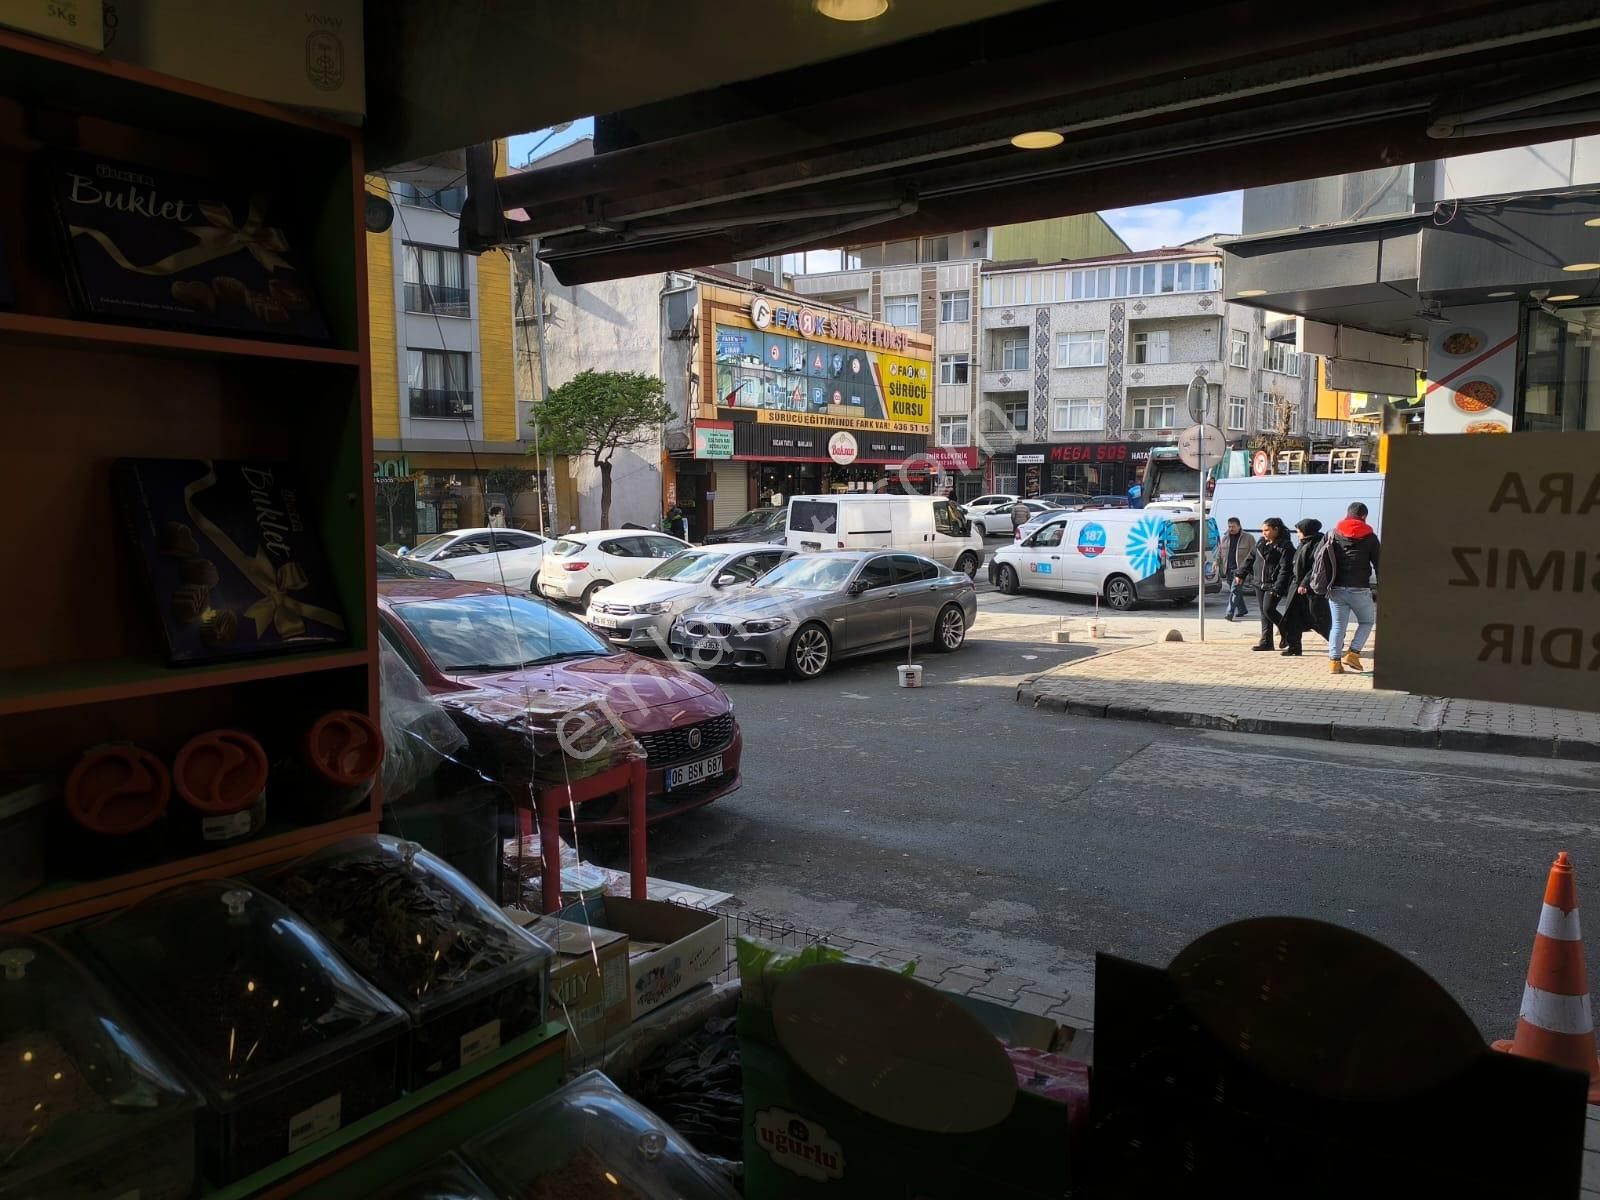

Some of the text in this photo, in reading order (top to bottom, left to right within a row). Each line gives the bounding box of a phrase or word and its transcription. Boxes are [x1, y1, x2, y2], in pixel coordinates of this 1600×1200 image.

[66, 171, 193, 223] Buklet
[775, 306, 826, 338] FARK
[829, 316, 874, 346] SÜRÜCÜ
[873, 326, 909, 353] KURSU
[889, 380, 927, 400] SÜRÜCÜ
[892, 400, 924, 417] KURSU
[768, 411, 930, 433] SÜRÜCÜ EĞİTİMİNDE FARK VAR! 436 51 15
[1050, 446, 1091, 461] MEGA
[1096, 445, 1128, 460] SOS
[240, 464, 292, 560] Buklet
[1084, 526, 1104, 541] 187
[672, 768, 683, 785] 06
[707, 755, 722, 773] 687
[761, 1127, 839, 1170] uğurlu
